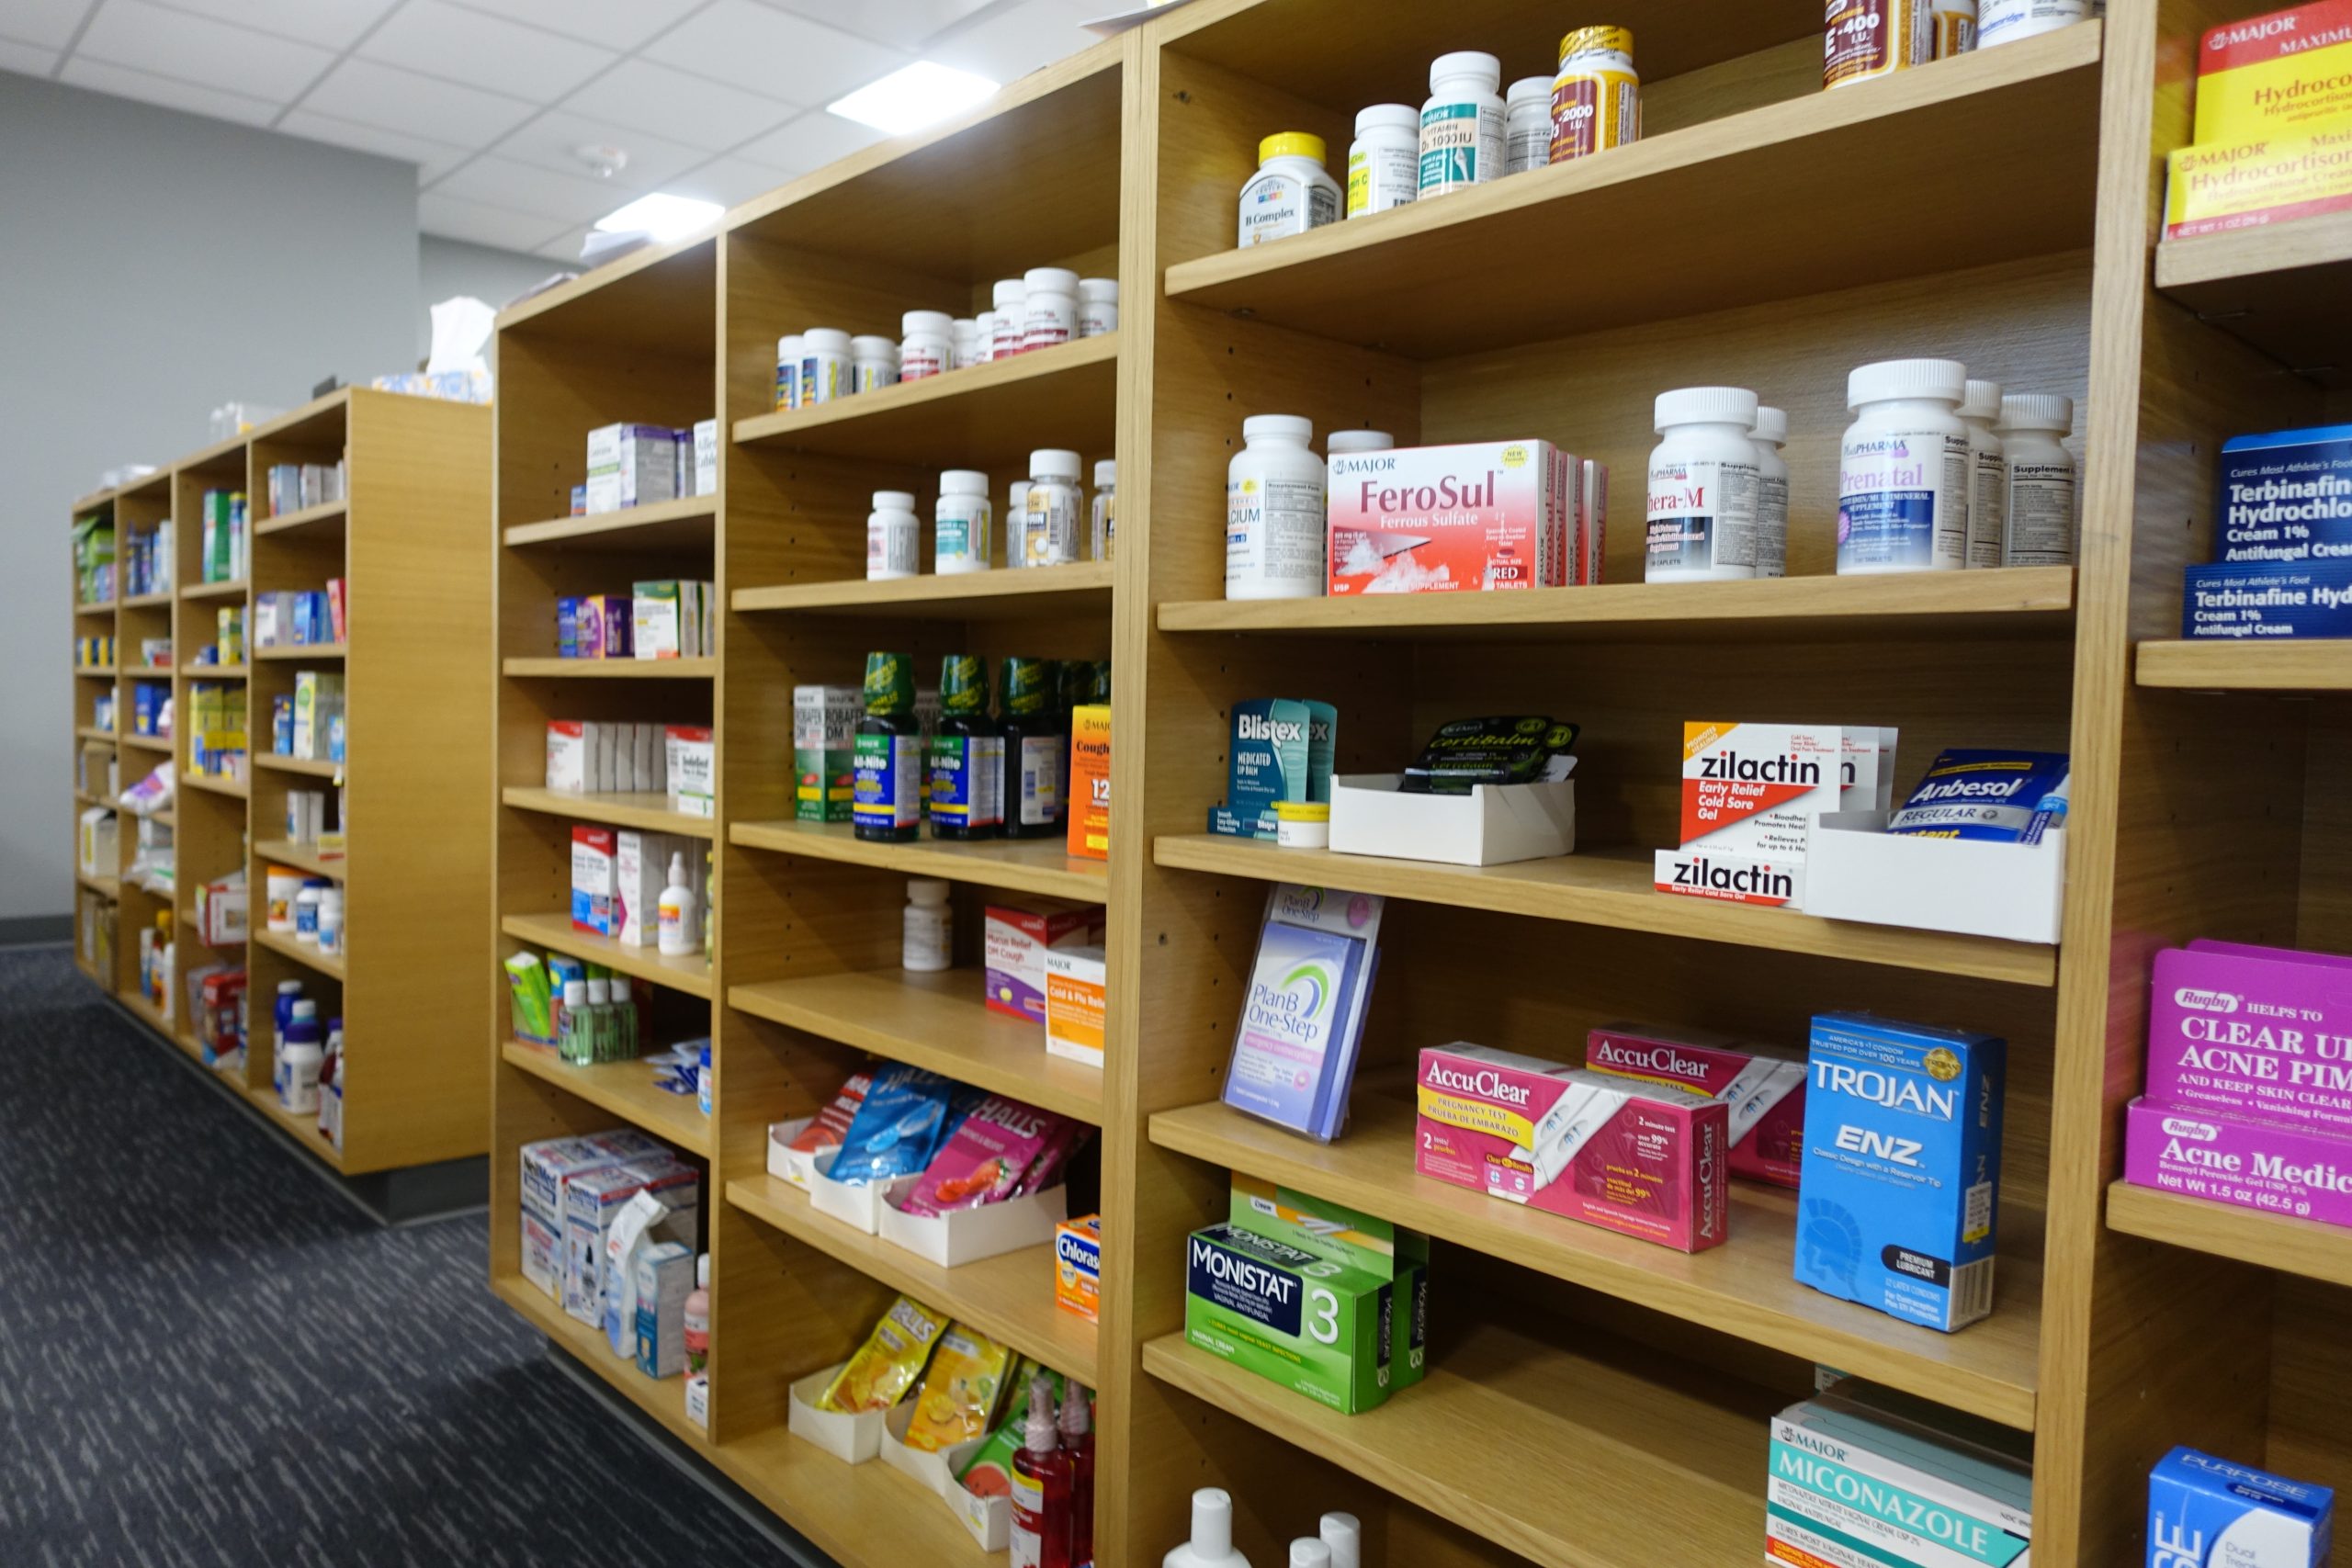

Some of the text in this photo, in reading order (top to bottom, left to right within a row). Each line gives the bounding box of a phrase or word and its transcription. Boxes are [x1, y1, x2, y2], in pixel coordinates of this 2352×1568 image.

[2228, 17, 2296, 45] MAJOR
[1428, 123, 1458, 137] VITAMIN
[2199, 142, 2267, 167] MAJOR
[1245, 209, 1295, 227] B Complex
[1345, 457, 1395, 472] MAJOR
[2231, 460, 2329, 479] Cures Most Athlete's
[1840, 463, 1923, 491] Prenatal
[1361, 470, 1495, 513] FeroSul
[2229, 475, 2352, 503] Terbinafin
[1380, 512, 1478, 529] Ferrous Sulfate
[1544, 502, 1553, 584] FeroSul
[2226, 525, 2310, 543] Cream 1%
[2225, 543, 2309, 562] Antifungal
[1493, 567, 1518, 580] RED
[2196, 576, 2311, 589] Cures Most Athlete's Foot
[1334, 583, 1350, 592] USP
[2195, 587, 2307, 608] Terbinafine
[2194, 609, 2262, 622] Cream 1%
[2193, 624, 2293, 637] Antifungal Cream
[1238, 714, 1301, 749] Blistex
[1686, 727, 1717, 750] PROMOTES
[1077, 740, 1110, 755] Cough
[1690, 733, 1718, 754] HEALING
[1238, 751, 1271, 767] MEDICATED
[1701, 750, 1820, 784] zilactin
[1245, 766, 1258, 776] BALM
[1092, 779, 1109, 799] 12
[1699, 781, 1766, 796] Early Relief
[1909, 778, 2023, 803] Anbesol
[1698, 795, 1754, 810] Cold Sore
[2043, 802, 2059, 810] gel
[1698, 807, 1718, 820] Gel
[1902, 808, 1977, 822] REGULAR
[1258, 819, 1275, 832] Blistex
[1754, 819, 1786, 830] Promotes
[1768, 843, 1778, 852] up
[1769, 835, 1801, 844] Relieves
[1673, 857, 1792, 897] zilactin
[1671, 885, 1687, 893] Early
[1688, 886, 1704, 895] Relief
[987, 932, 1032, 951] Mucus Relief
[1001, 948, 1024, 962] Cough
[1047, 957, 1071, 971] MAJOR
[1050, 987, 1086, 1003] Cold & Flu
[2182, 990, 2231, 1010] Rugby
[2246, 1002, 2323, 1022] HELPS TO
[1249, 1003, 1318, 1043] One-Step
[1827, 1035, 1904, 1055] AMERICA'S CONDOM
[2181, 1017, 2305, 1055] CLEAR
[1812, 1039, 1920, 1067] TRUSTED FOR OVER 100 YEARS
[2177, 1045, 2279, 1080] ACNE
[1812, 1059, 1953, 1121] TROJAN
[2178, 1074, 2351, 1111] AND KEEP SKIN CLEAR
[1437, 1097, 1507, 1122] PREGNANCY TEST
[2186, 1089, 2311, 1119] Greaseless Vanishing
[971, 1099, 1047, 1140] HALLS
[1428, 1105, 1519, 1137] PRUEBA DE EMBARAZO
[1639, 1116, 1676, 1134] 2 minute test
[2169, 1121, 2211, 1137] Rugby
[1424, 1133, 1432, 1150] 2
[1638, 1141, 1661, 1150] accurate
[1651, 1134, 1668, 1145] 99%
[1836, 1124, 1922, 1167] ENZ
[1487, 1153, 1533, 1174] Clear Results
[2159, 1138, 2241, 1172] Acne
[1607, 1165, 1639, 1178] prueba 2
[1813, 1146, 1838, 1159] Classic
[1839, 1154, 1865, 1168] Design
[1866, 1161, 1883, 1171] with
[1890, 1168, 1927, 1183] Reservoir
[1928, 1177, 1940, 1188] Tip
[2159, 1160, 2264, 1188] Benzoyl Peroxide Gel
[1635, 1189, 1651, 1198] 99%
[2158, 1172, 2310, 1216] Net Wt 1.5 oz (42.5 g)
[1216, 1225, 1316, 1262] MONISTAT
[1896, 1259, 1935, 1279] LUBRICANT
[1900, 1251, 1934, 1269] PREMIUM
[1193, 1240, 1295, 1304] MONISTAT
[1308, 1288, 1339, 1345] 3
[1214, 1292, 1235, 1307] VAGINAL
[1236, 1303, 1270, 1322] ANTIFUNGAL
[1795, 1432, 1845, 1462] MAJOR
[2182, 1454, 2310, 1499] PURPOSE
[1778, 1494, 1803, 1512] VAGINAL
[1779, 1450, 1988, 1555] MICONAZOLE
[1844, 1506, 1870, 1526] VAGINAL
[2000, 1511, 2016, 1524] NDC
[1776, 1522, 1854, 1562] CURES MOST VAGINAL
[2225, 1541, 2256, 1559] Dual
